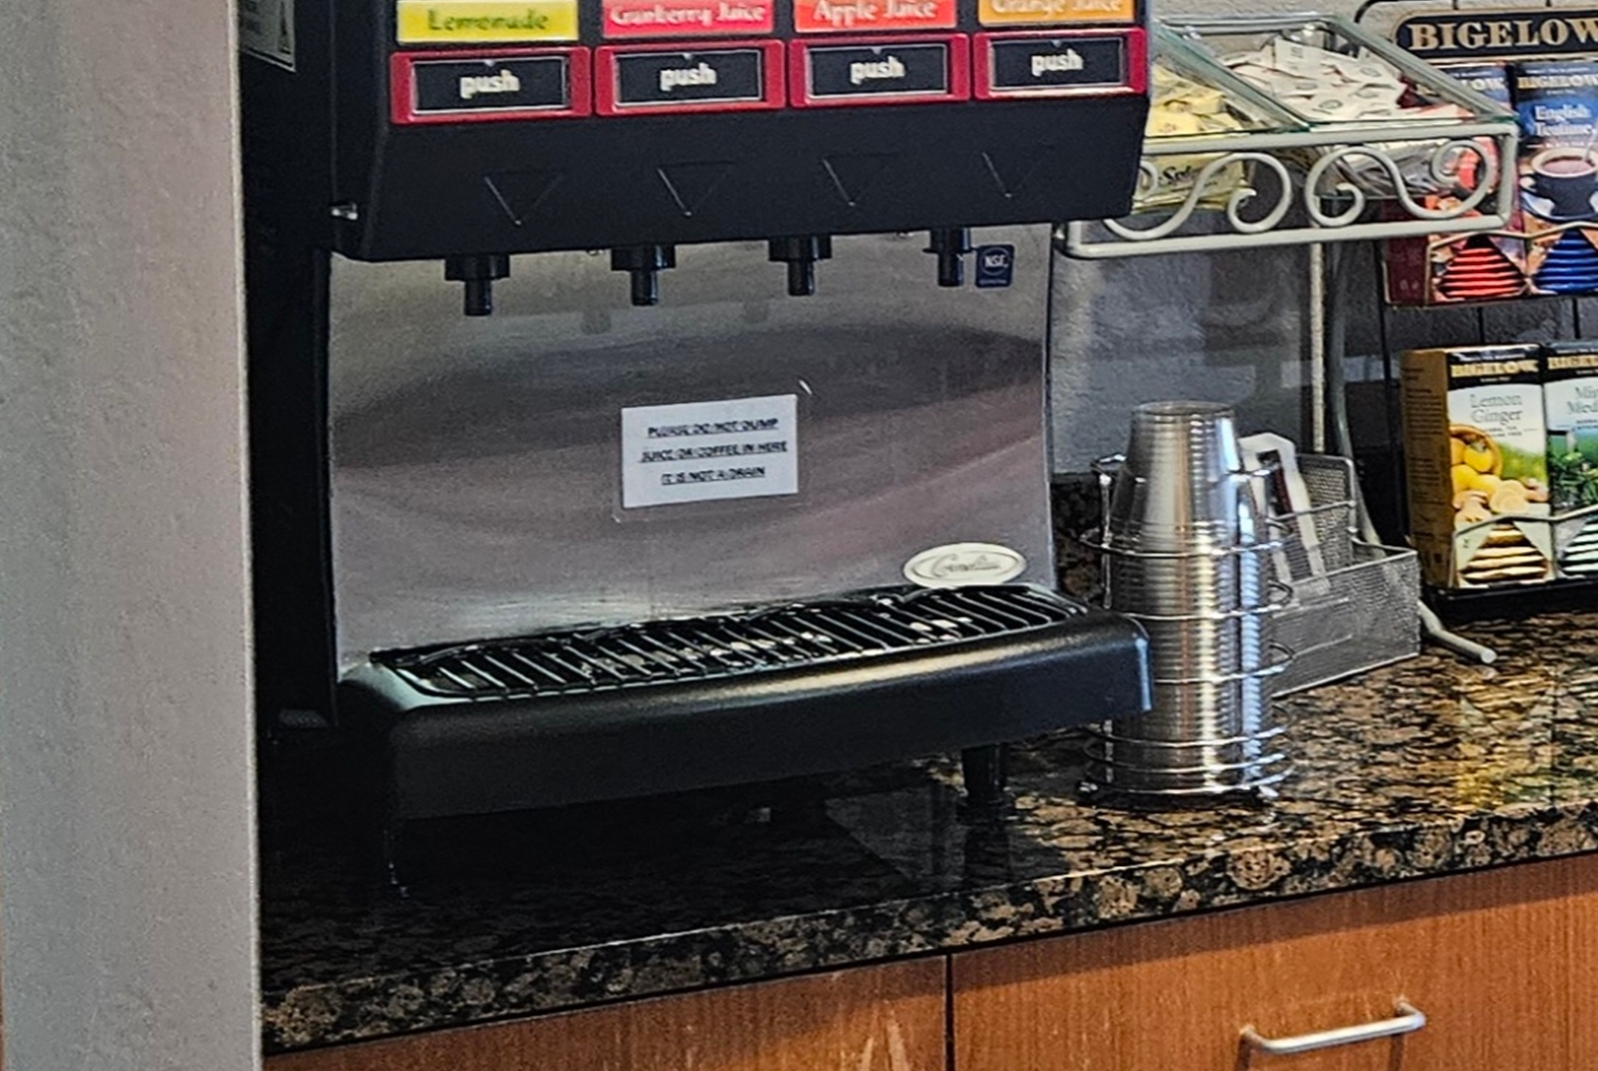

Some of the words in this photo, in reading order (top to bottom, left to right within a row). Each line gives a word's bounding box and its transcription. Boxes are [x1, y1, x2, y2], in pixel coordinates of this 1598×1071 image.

[426, 8, 550, 31] Lemonade
[609, 1, 714, 27] Cranberry
[715, 0, 766, 24] Juice
[850, 55, 906, 85] push
[1030, 48, 1084, 78] push
[459, 68, 521, 100] push
[658, 61, 718, 91] push
[1533, 104, 1592, 124] English
[1450, 359, 1540, 378] BIGELOW
[1469, 393, 1523, 408] Lemon
[1471, 408, 1523, 427] Ginger
[696, 444, 740, 458] COFFEE
[742, 443, 755, 456] IN
[758, 440, 788, 454] HERE
[728, 466, 766, 480] DRAIN
